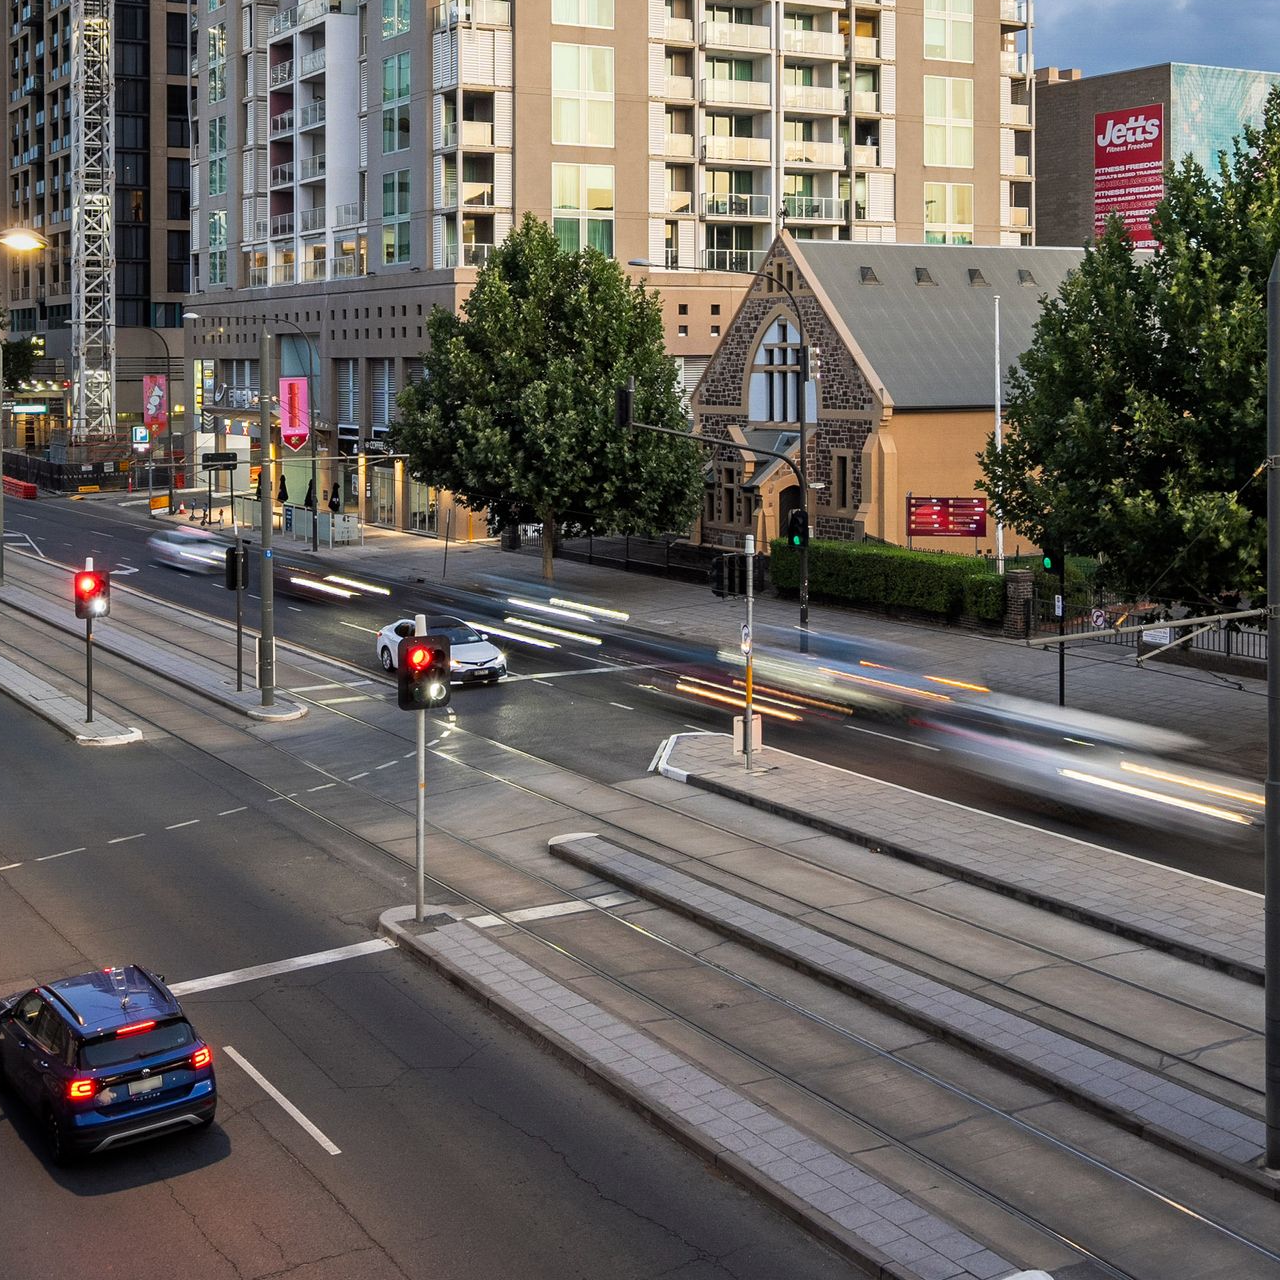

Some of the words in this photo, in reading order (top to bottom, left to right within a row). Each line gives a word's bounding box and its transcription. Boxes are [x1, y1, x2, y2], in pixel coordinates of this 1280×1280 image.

[1097, 115, 1160, 147] Jetts
[1127, 142, 1153, 150] Freedom
[1095, 165, 1124, 174] FITNESS
[1126, 160, 1163, 170] FREEDOM
[1095, 189, 1124, 197] FITNESS
[1126, 184, 1163, 194] FREEDOM
[1126, 208, 1156, 217] FREEDO
[137, 429, 147, 440] P
